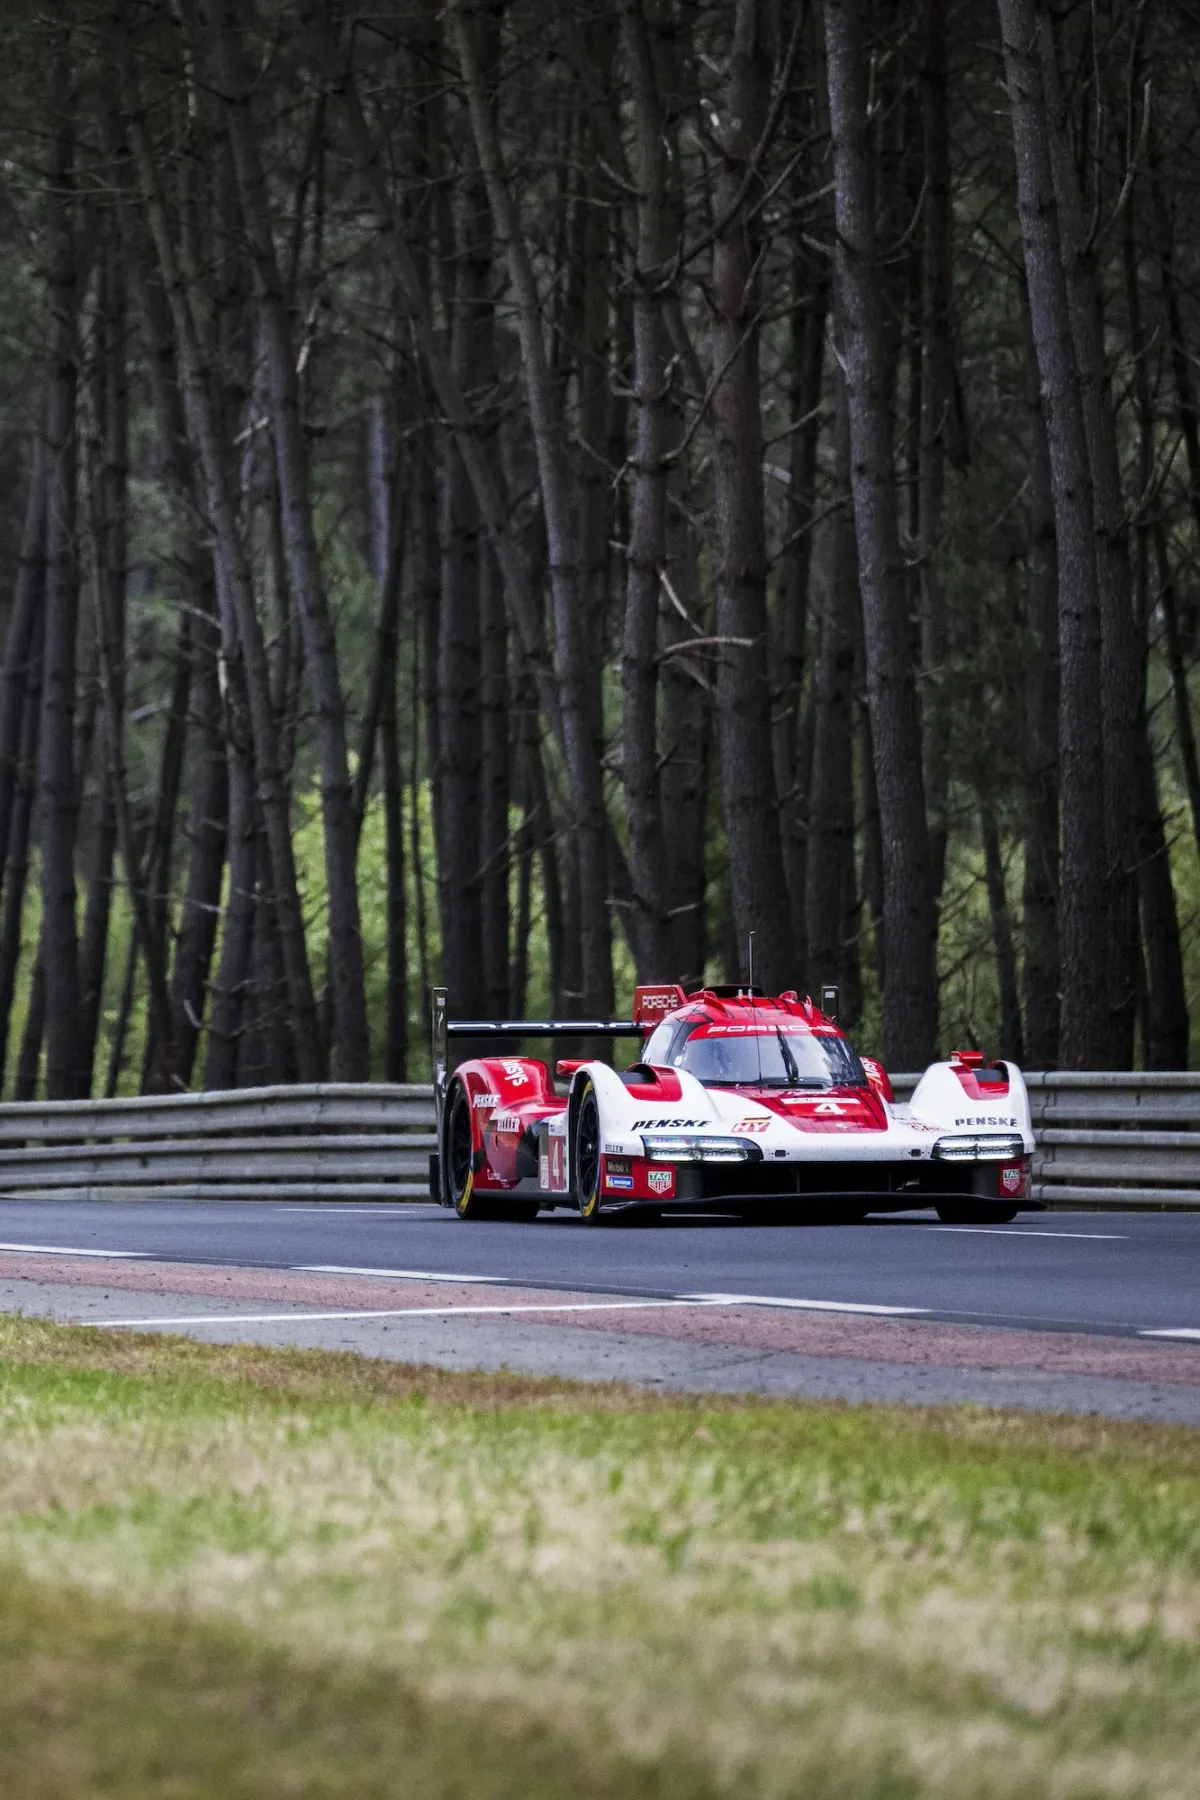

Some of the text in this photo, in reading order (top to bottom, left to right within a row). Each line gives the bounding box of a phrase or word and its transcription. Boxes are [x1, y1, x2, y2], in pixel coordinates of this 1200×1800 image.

[642, 995, 678, 1009] PORSCHE
[707, 1024, 837, 1034] PORSCHE
[500, 1060, 529, 1087] nsys
[473, 1095, 501, 1108] PENSKE
[813, 1103, 847, 1115] 4
[631, 1119, 712, 1132] PENSKE
[955, 1117, 1018, 1128] PENSKE
[650, 1172, 670, 1180] TAG
[650, 1181, 670, 1193] HEUER
